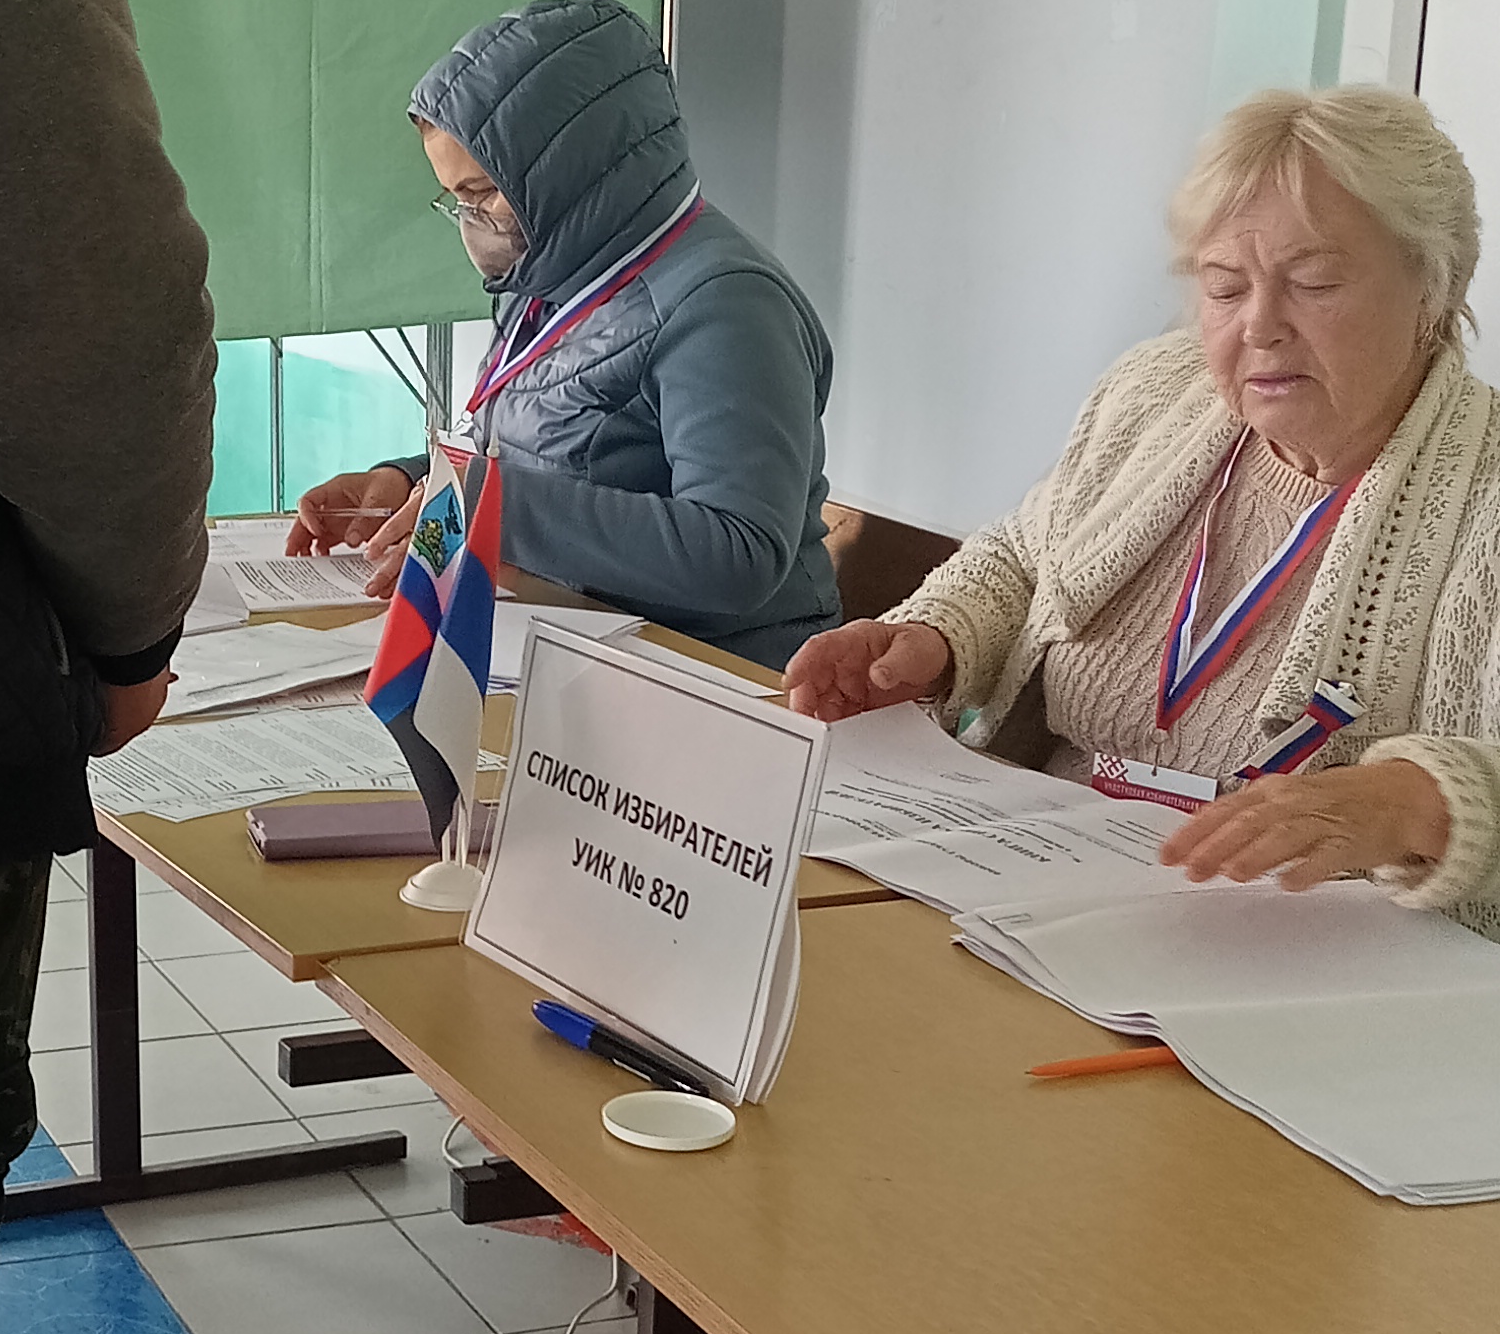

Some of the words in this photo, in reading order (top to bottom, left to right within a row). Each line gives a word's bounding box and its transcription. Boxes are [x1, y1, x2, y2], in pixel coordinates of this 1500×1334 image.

[526, 749, 610, 813] СПИСОК
[612, 787, 775, 888] ИЗБИРАТЕЛЕЙ
[571, 836, 617, 887] УИК
[617, 862, 646, 900] №
[648, 878, 690, 921] 820
